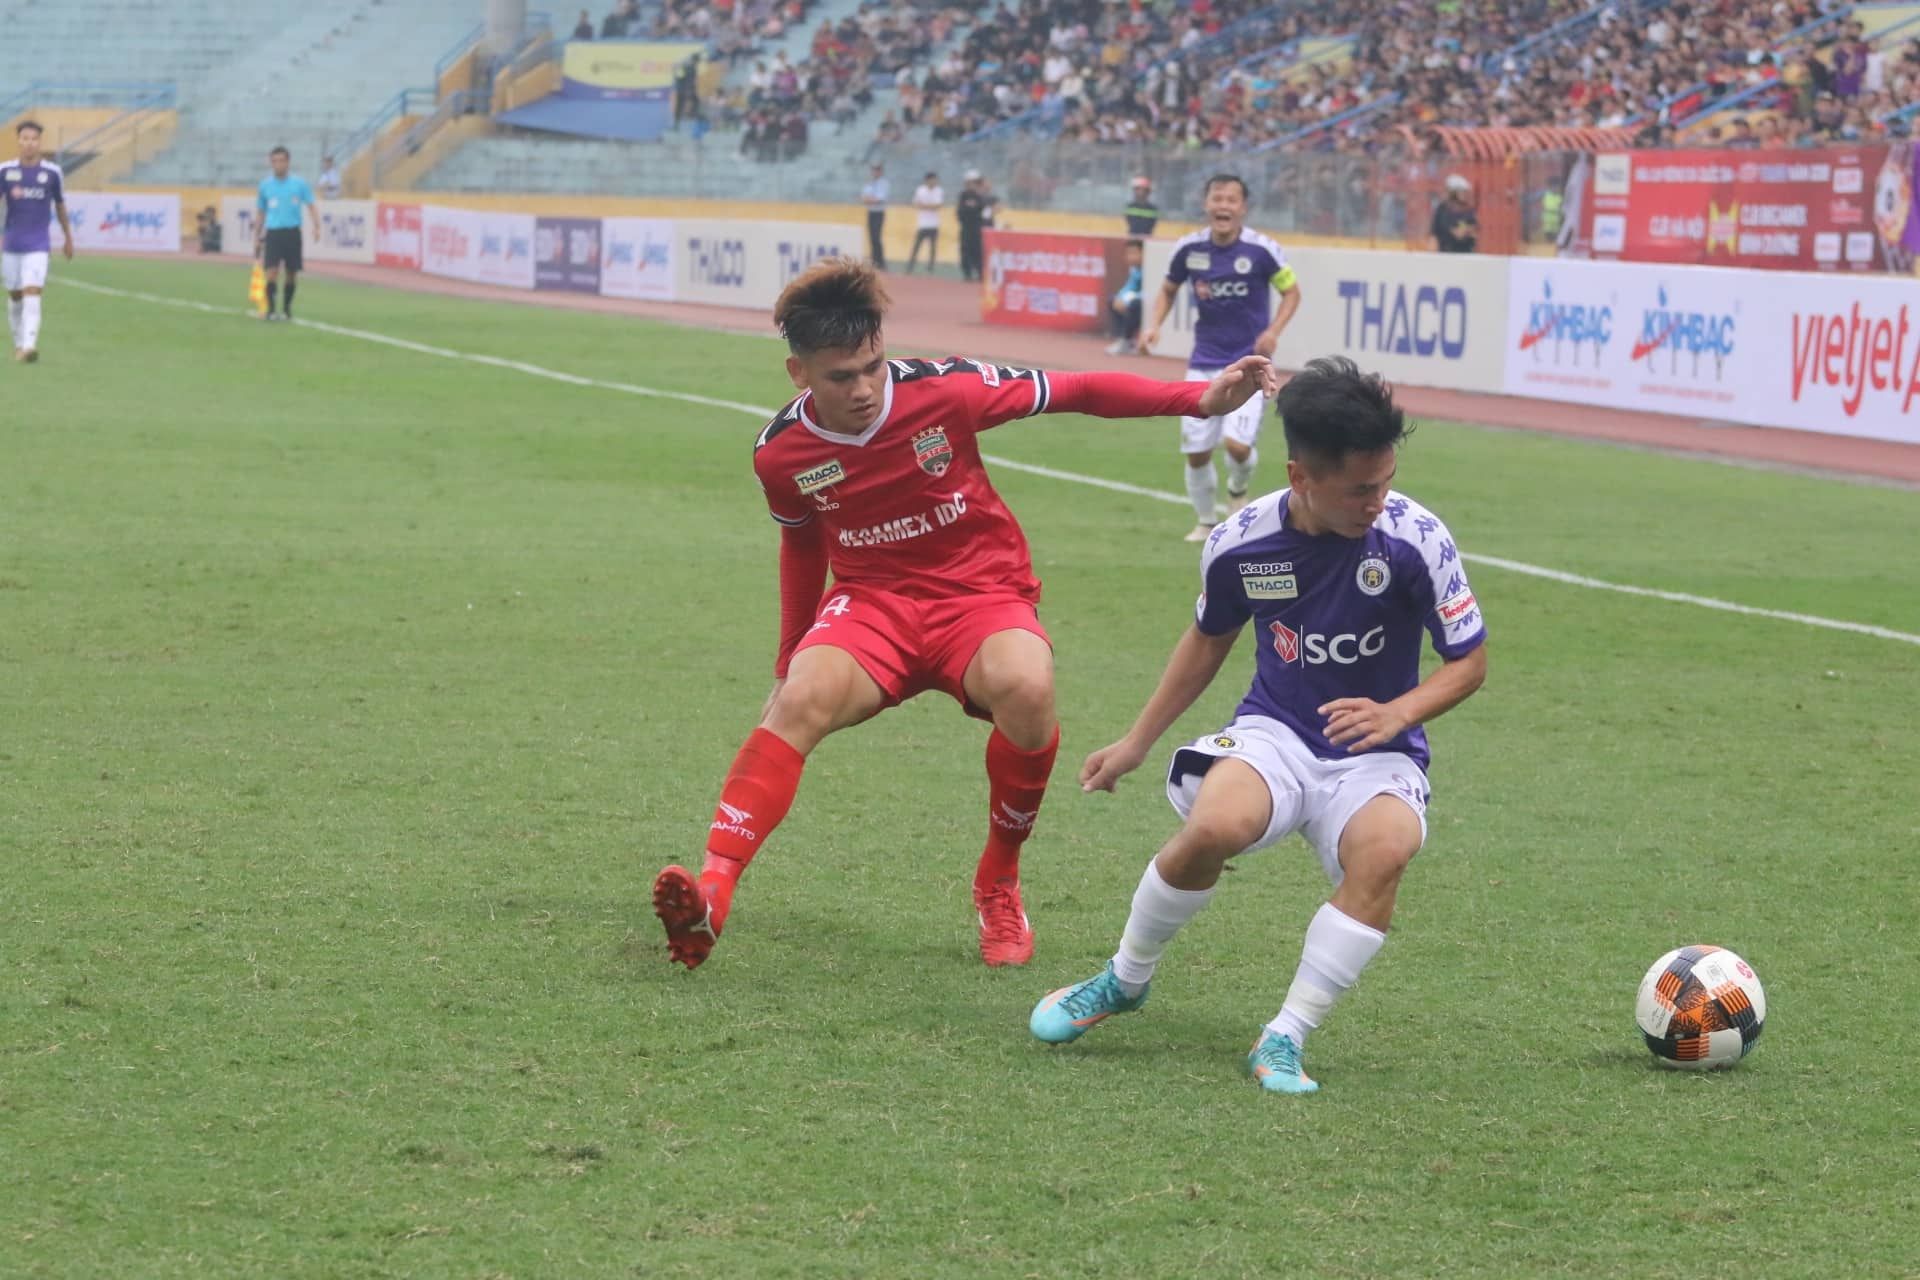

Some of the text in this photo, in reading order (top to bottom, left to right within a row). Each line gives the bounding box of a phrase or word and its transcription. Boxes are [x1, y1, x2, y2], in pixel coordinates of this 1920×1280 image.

[1213, 281, 1249, 297] SCG
[1338, 281, 1467, 358] THACO
[797, 464, 840, 487] THACO
[934, 492, 967, 527] IDC
[1239, 561, 1293, 575] Kappa
[1246, 579, 1293, 591] THACO
[1304, 625, 1385, 665] SCG
